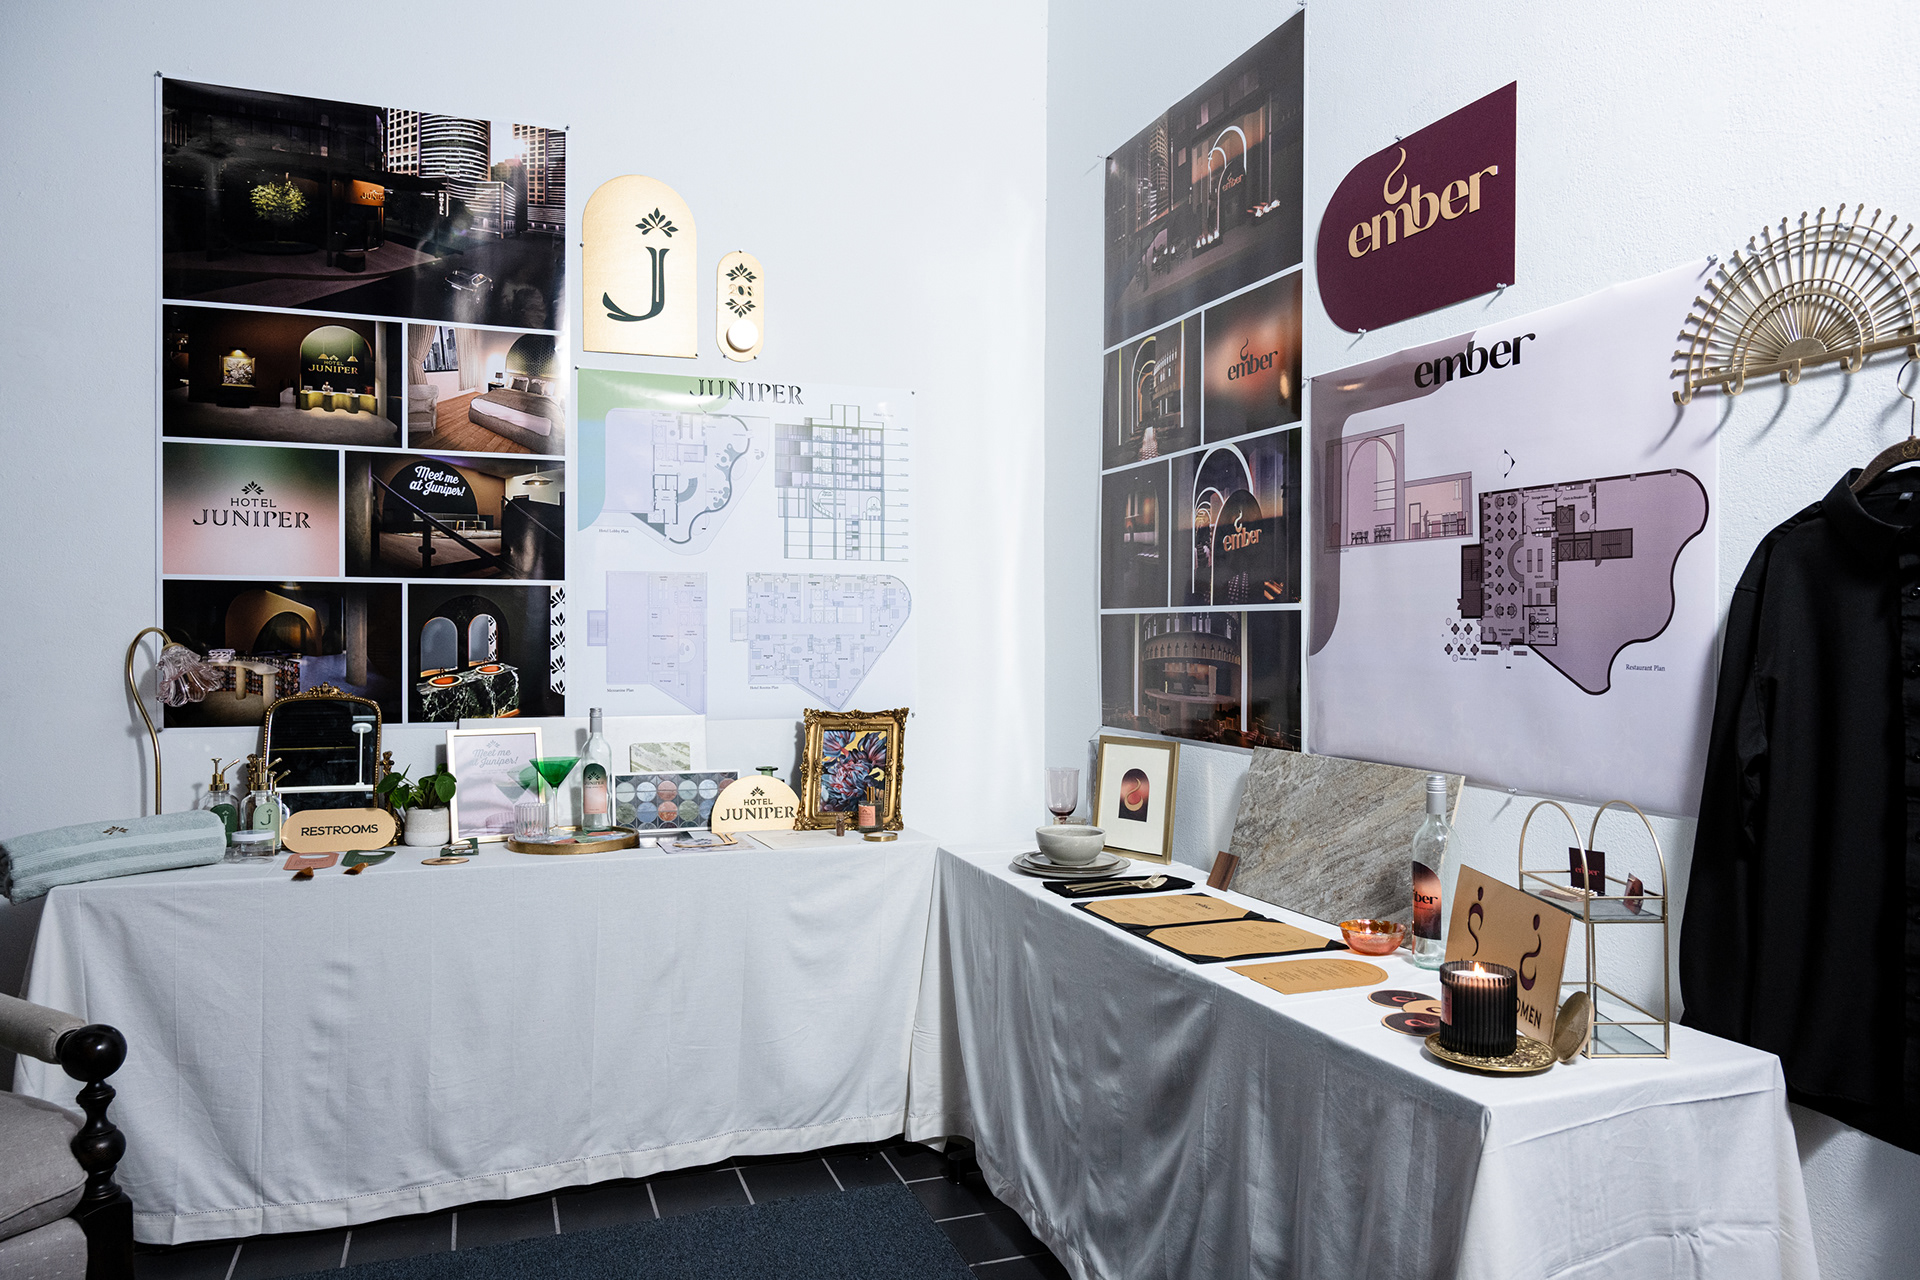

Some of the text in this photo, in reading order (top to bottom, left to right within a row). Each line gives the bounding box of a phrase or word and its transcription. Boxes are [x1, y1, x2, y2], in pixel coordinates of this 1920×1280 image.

[1348, 165, 1498, 258] ember
[602, 246, 670, 322] J
[728, 283, 754, 297] 208
[1227, 350, 1278, 381] ember
[1414, 333, 1536, 389] ember
[308, 364, 358, 375] JUNIPER
[689, 379, 804, 405] JUNIPER
[414, 465, 460, 484] Meet me
[409, 480, 466, 497] at Juniper!
[230, 497, 277, 508] HOTEL
[192, 508, 311, 529] JUNIPER
[1222, 526, 1263, 552] ember
[1625, 663, 1666, 672] Restaurant Plan
[472, 749, 497, 758] Meet
[479, 756, 519, 769] Juniper!
[743, 798, 773, 806] HOTEL
[260, 813, 272, 826] J
[720, 805, 796, 821] JUNIPER
[301, 824, 379, 837] RESTROOMS
